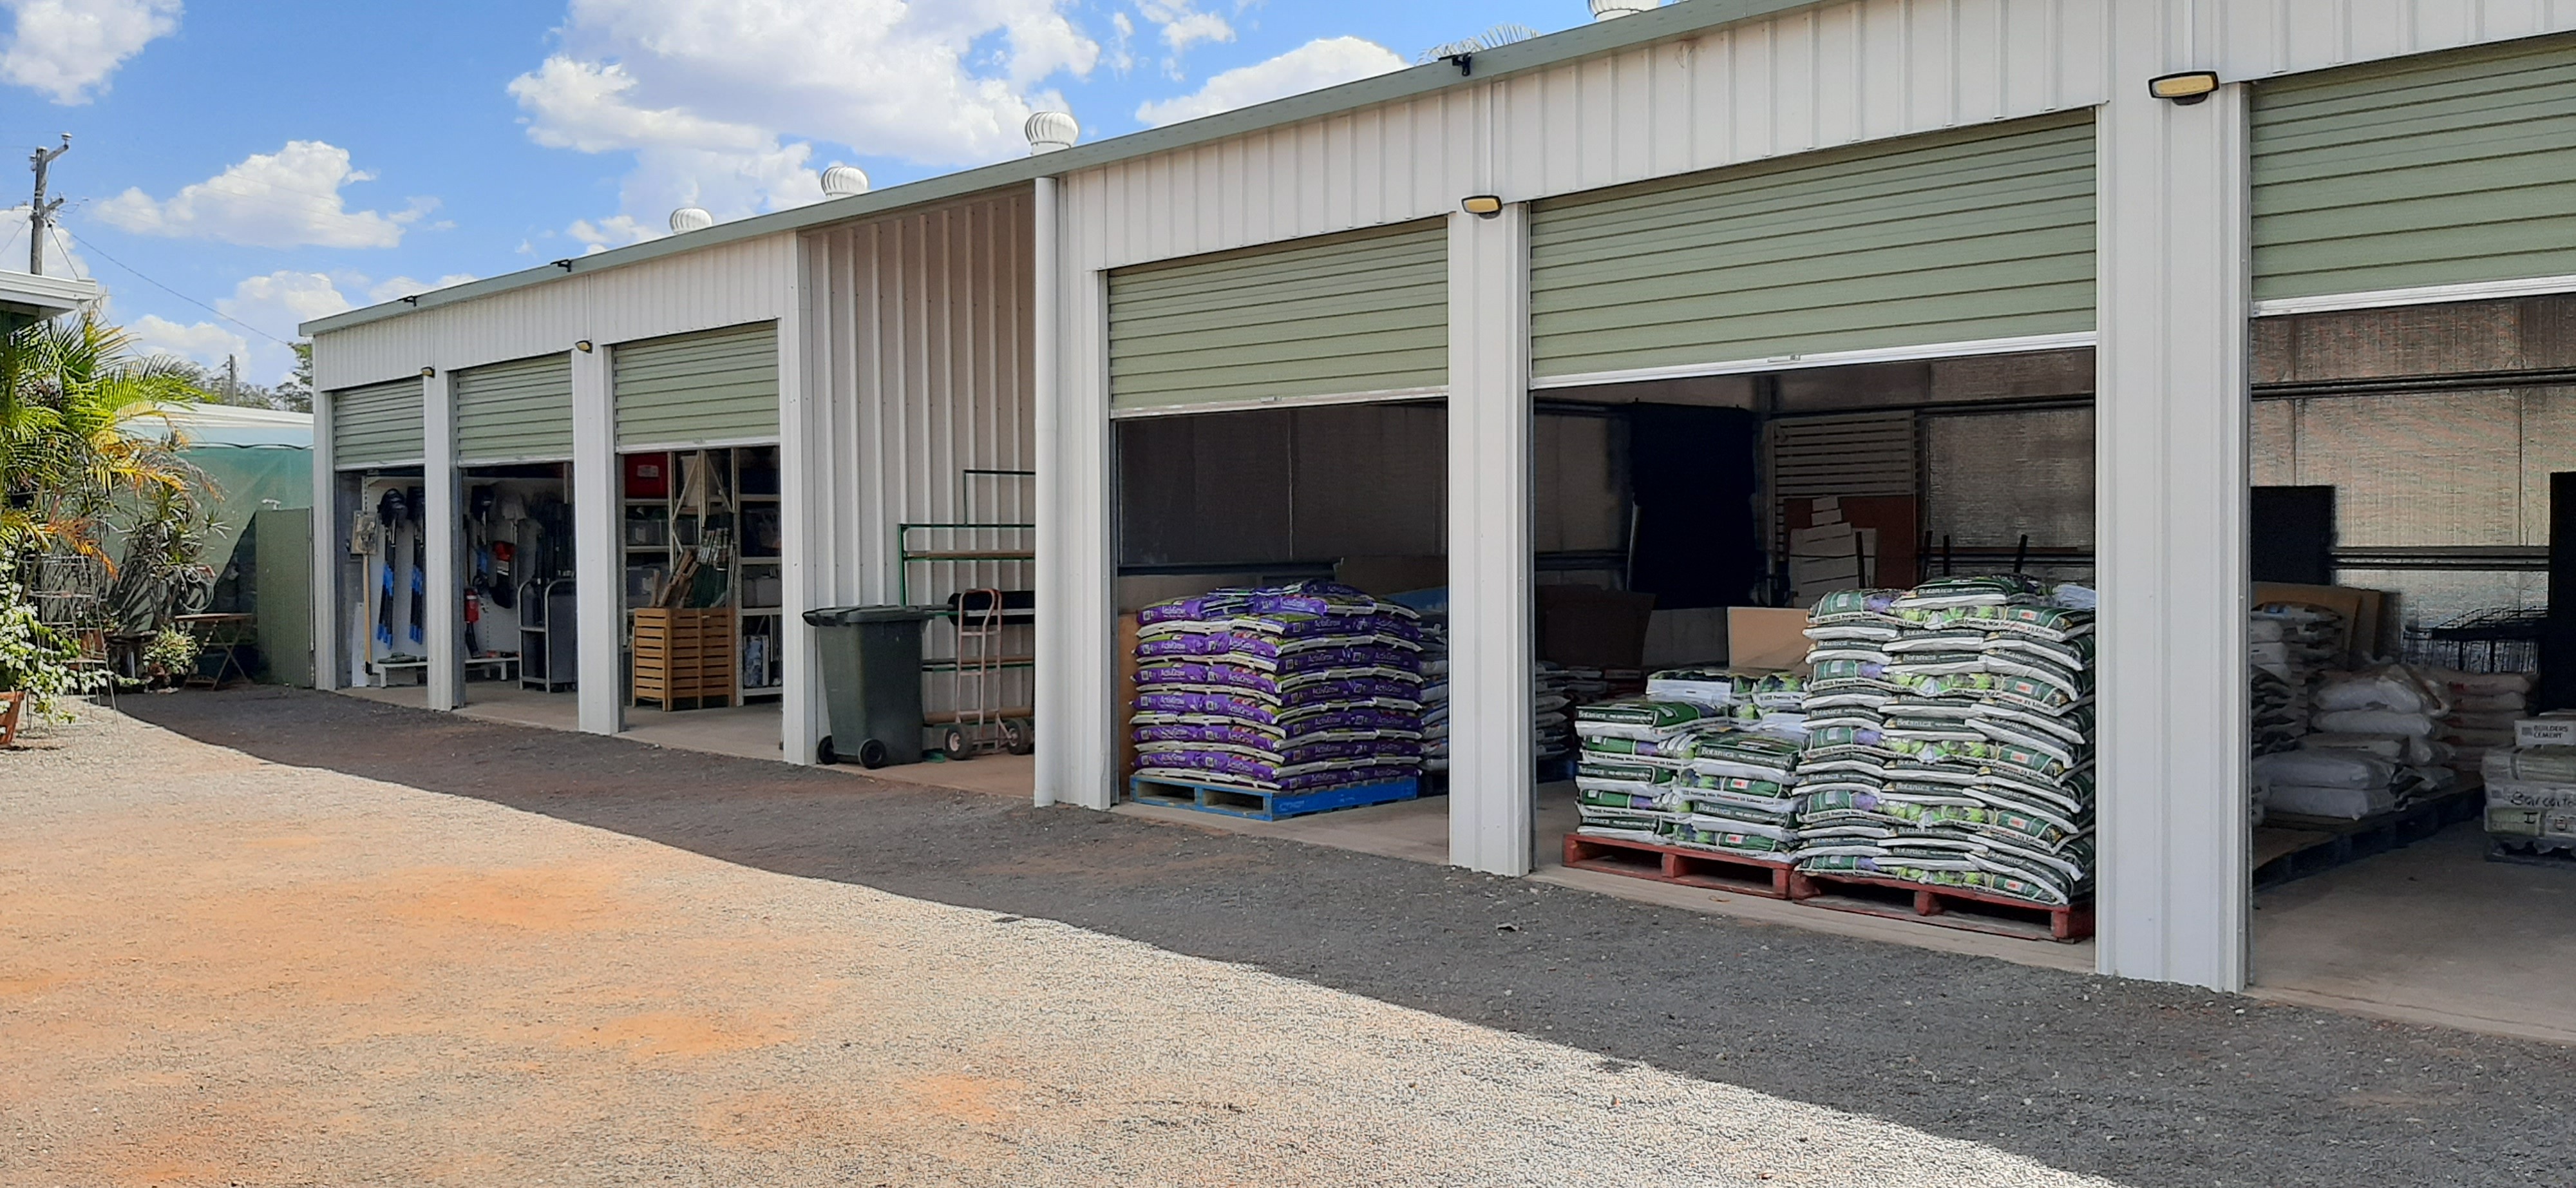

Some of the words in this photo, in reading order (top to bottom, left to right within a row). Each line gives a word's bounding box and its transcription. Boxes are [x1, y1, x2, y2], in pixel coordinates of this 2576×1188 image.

[1897, 718, 1932, 727] Botanica
[1701, 746, 1734, 759] Botanica
[1698, 802, 1732, 816] Botanica
